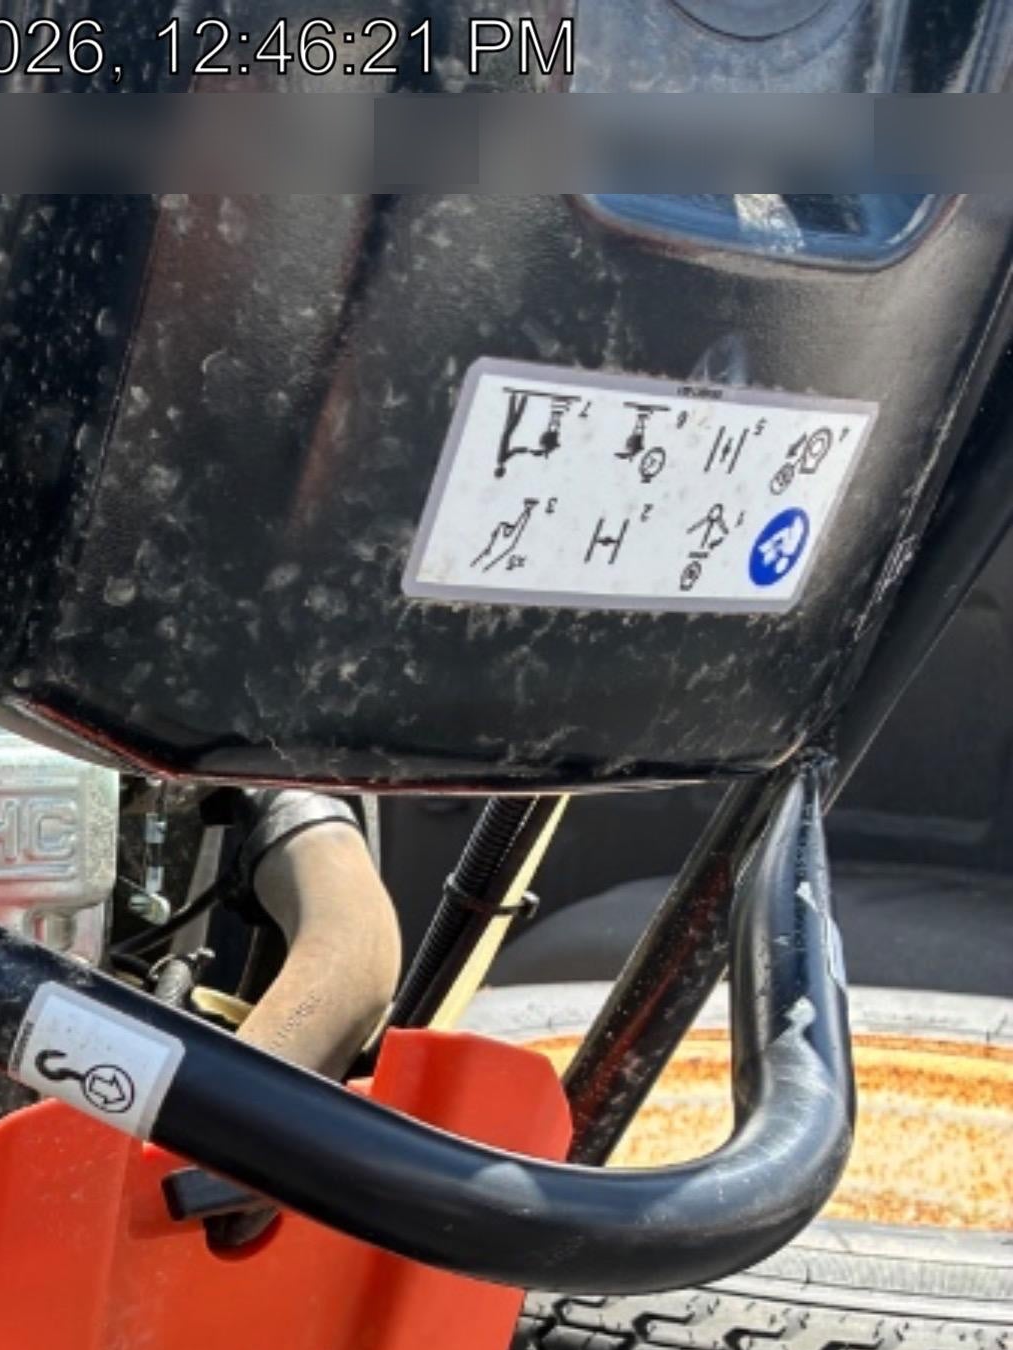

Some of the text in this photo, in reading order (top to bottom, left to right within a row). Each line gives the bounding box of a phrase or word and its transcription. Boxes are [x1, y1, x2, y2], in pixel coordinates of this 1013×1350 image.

[753, 418, 768, 437] 5
[544, 497, 558, 515] 3
[640, 503, 655, 523] 2
